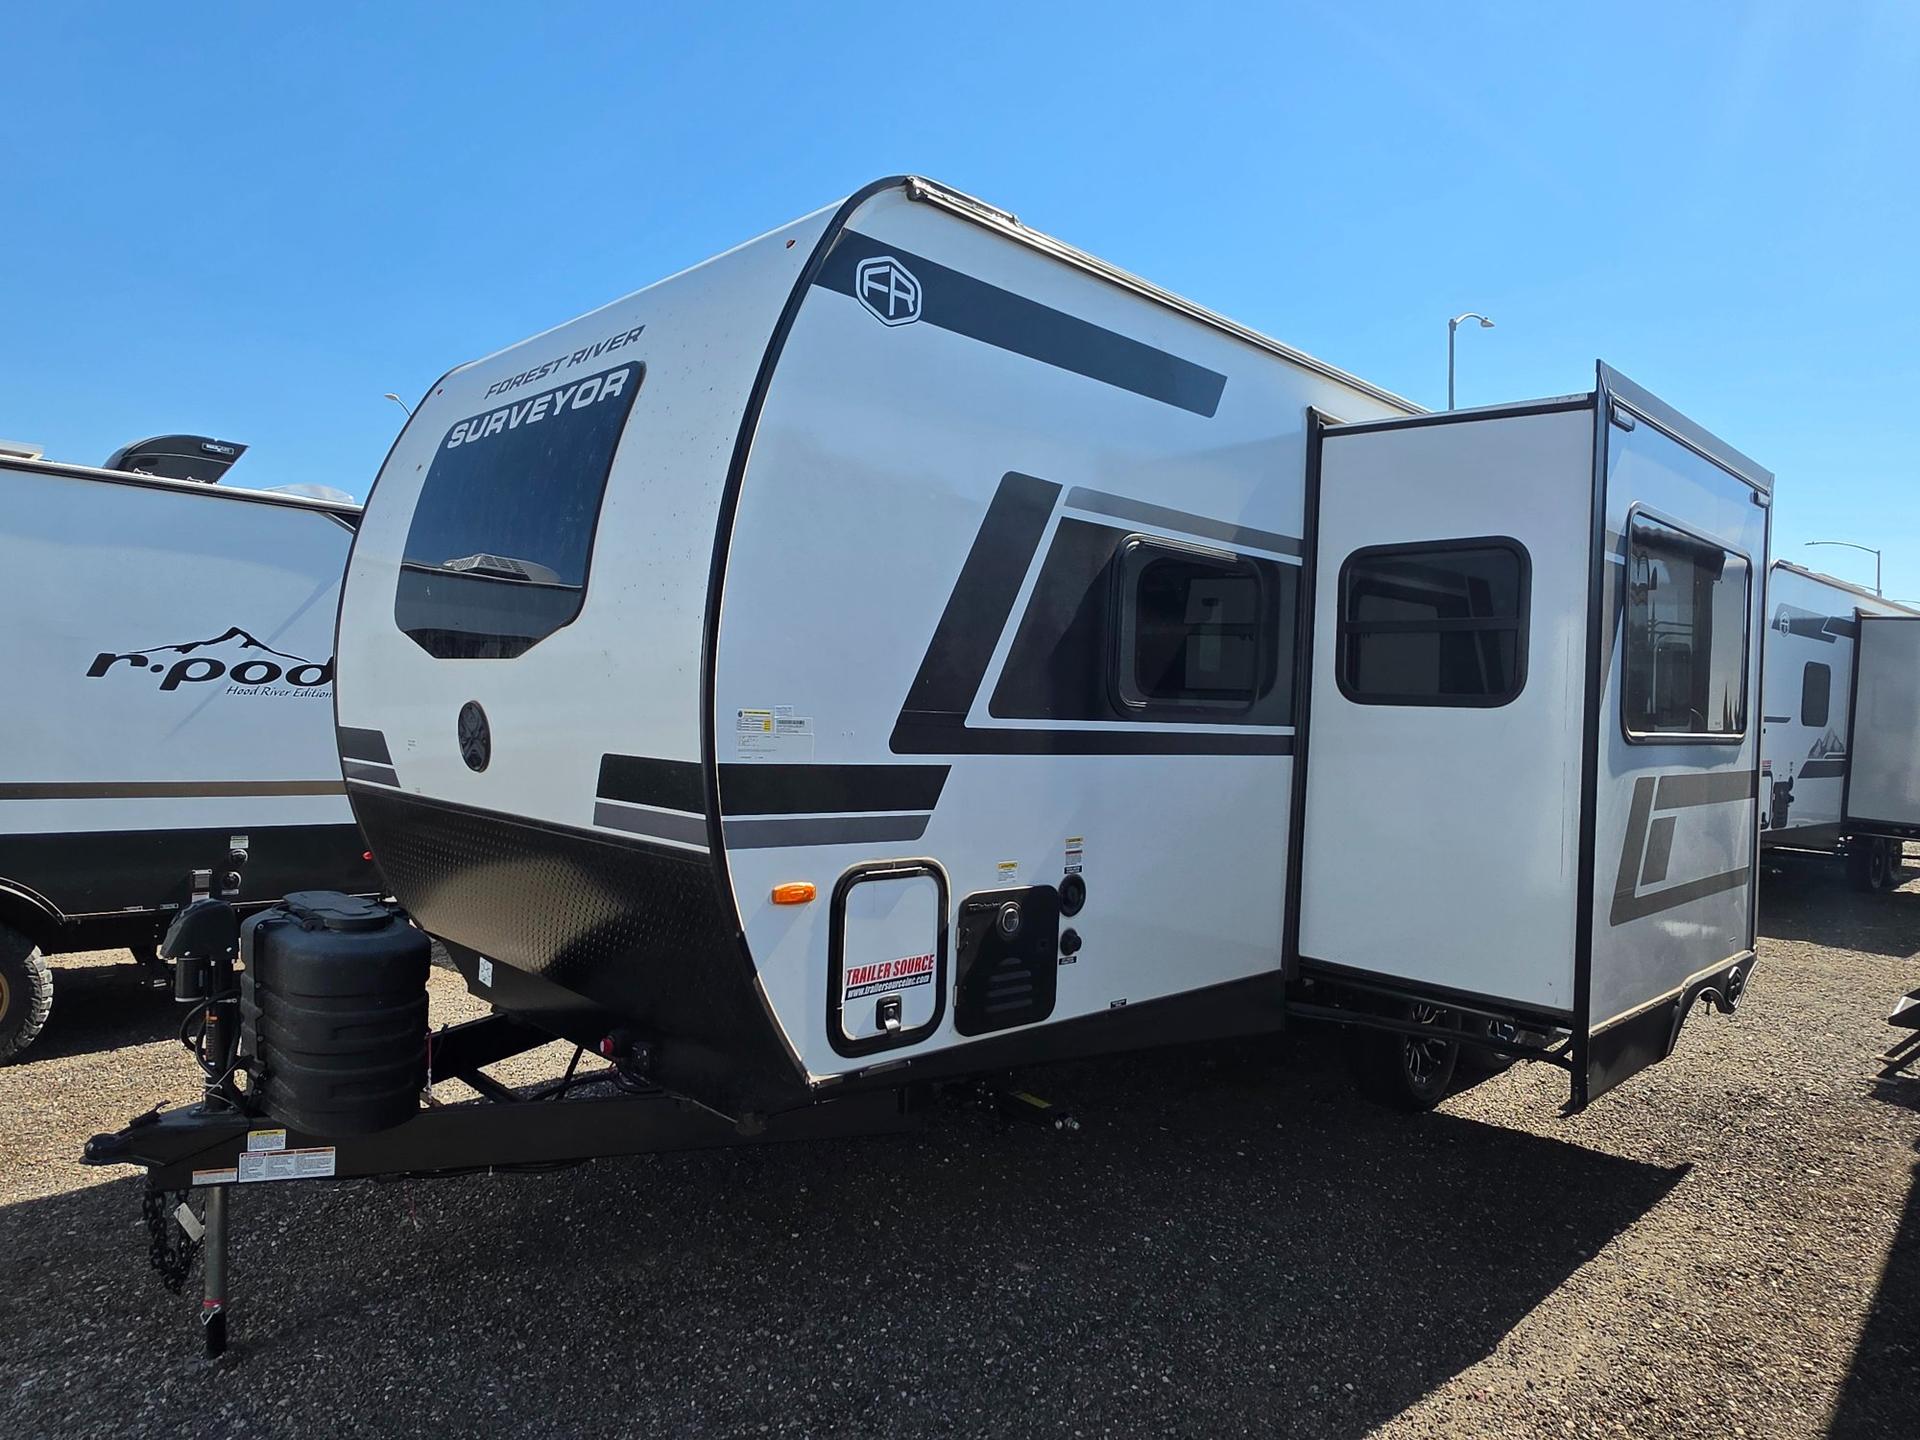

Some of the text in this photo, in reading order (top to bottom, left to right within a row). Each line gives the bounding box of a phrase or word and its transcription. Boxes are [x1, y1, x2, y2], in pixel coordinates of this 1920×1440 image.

[863, 265, 916, 316] FR
[484, 324, 646, 400] FOREST RIVER
[447, 368, 630, 449] SURVEYOR
[226, 685, 332, 698] Hood River Edition
[846, 954, 935, 986] TRAILER SOURCE
[847, 974, 930, 998] www.trailersourceinc.com
